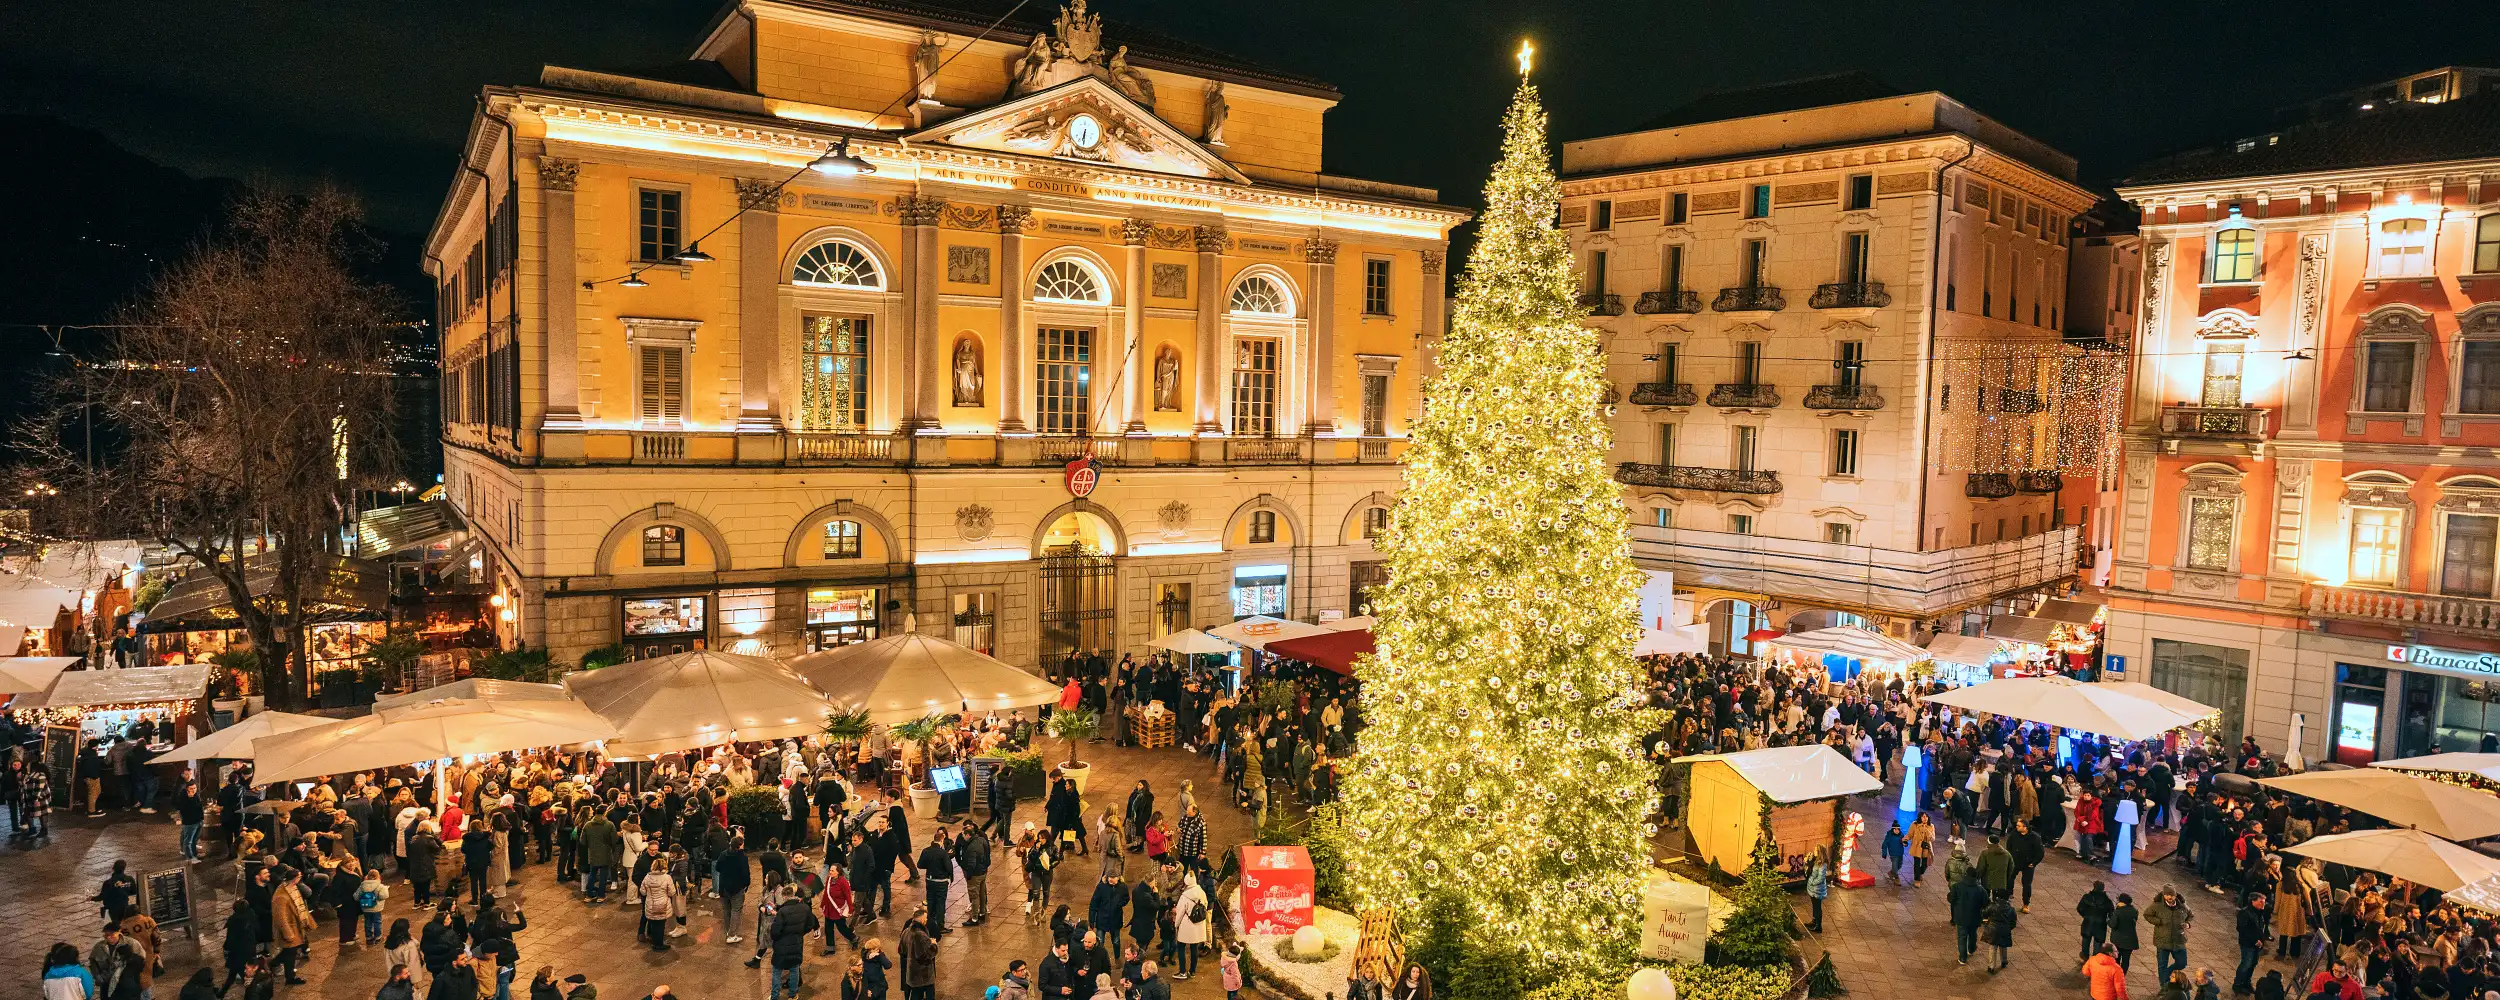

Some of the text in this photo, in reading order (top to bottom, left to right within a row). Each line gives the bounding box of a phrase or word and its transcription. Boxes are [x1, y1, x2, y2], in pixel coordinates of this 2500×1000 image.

[935, 169, 964, 179] AERE
[975, 174, 1018, 187] CIVIVM
[1028, 180, 1088, 195] CONDITVM
[1097, 189, 1126, 199] ANNO
[2412, 647, 2500, 674] BancaSt
[1661, 908, 1687, 926] Tanti
[1658, 923, 1690, 944] Auguri
